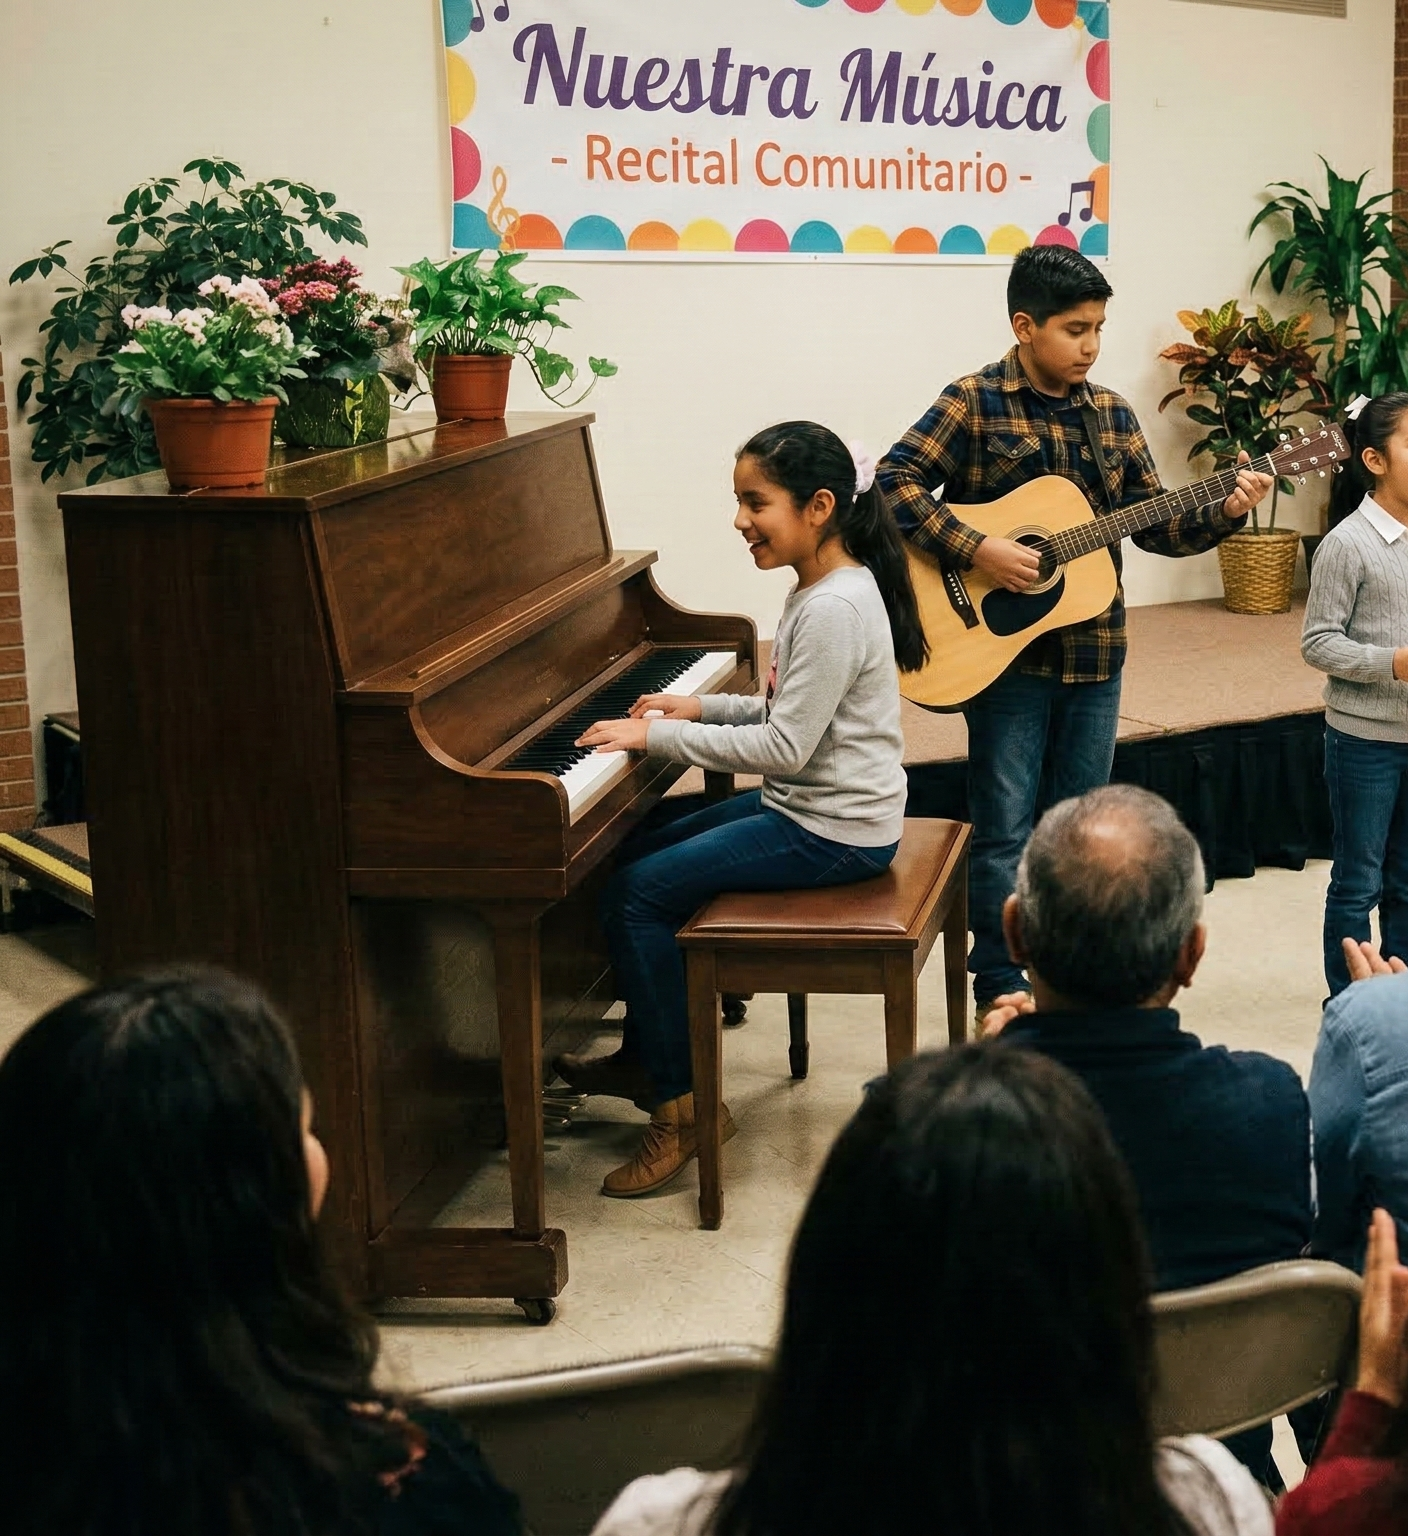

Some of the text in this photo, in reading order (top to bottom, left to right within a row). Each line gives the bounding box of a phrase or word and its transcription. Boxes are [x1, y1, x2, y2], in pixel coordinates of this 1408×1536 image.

[513, 23, 1067, 132] Nuestra Música
[586, 135, 738, 185] Recital
[755, 142, 1008, 194] Comunitario
